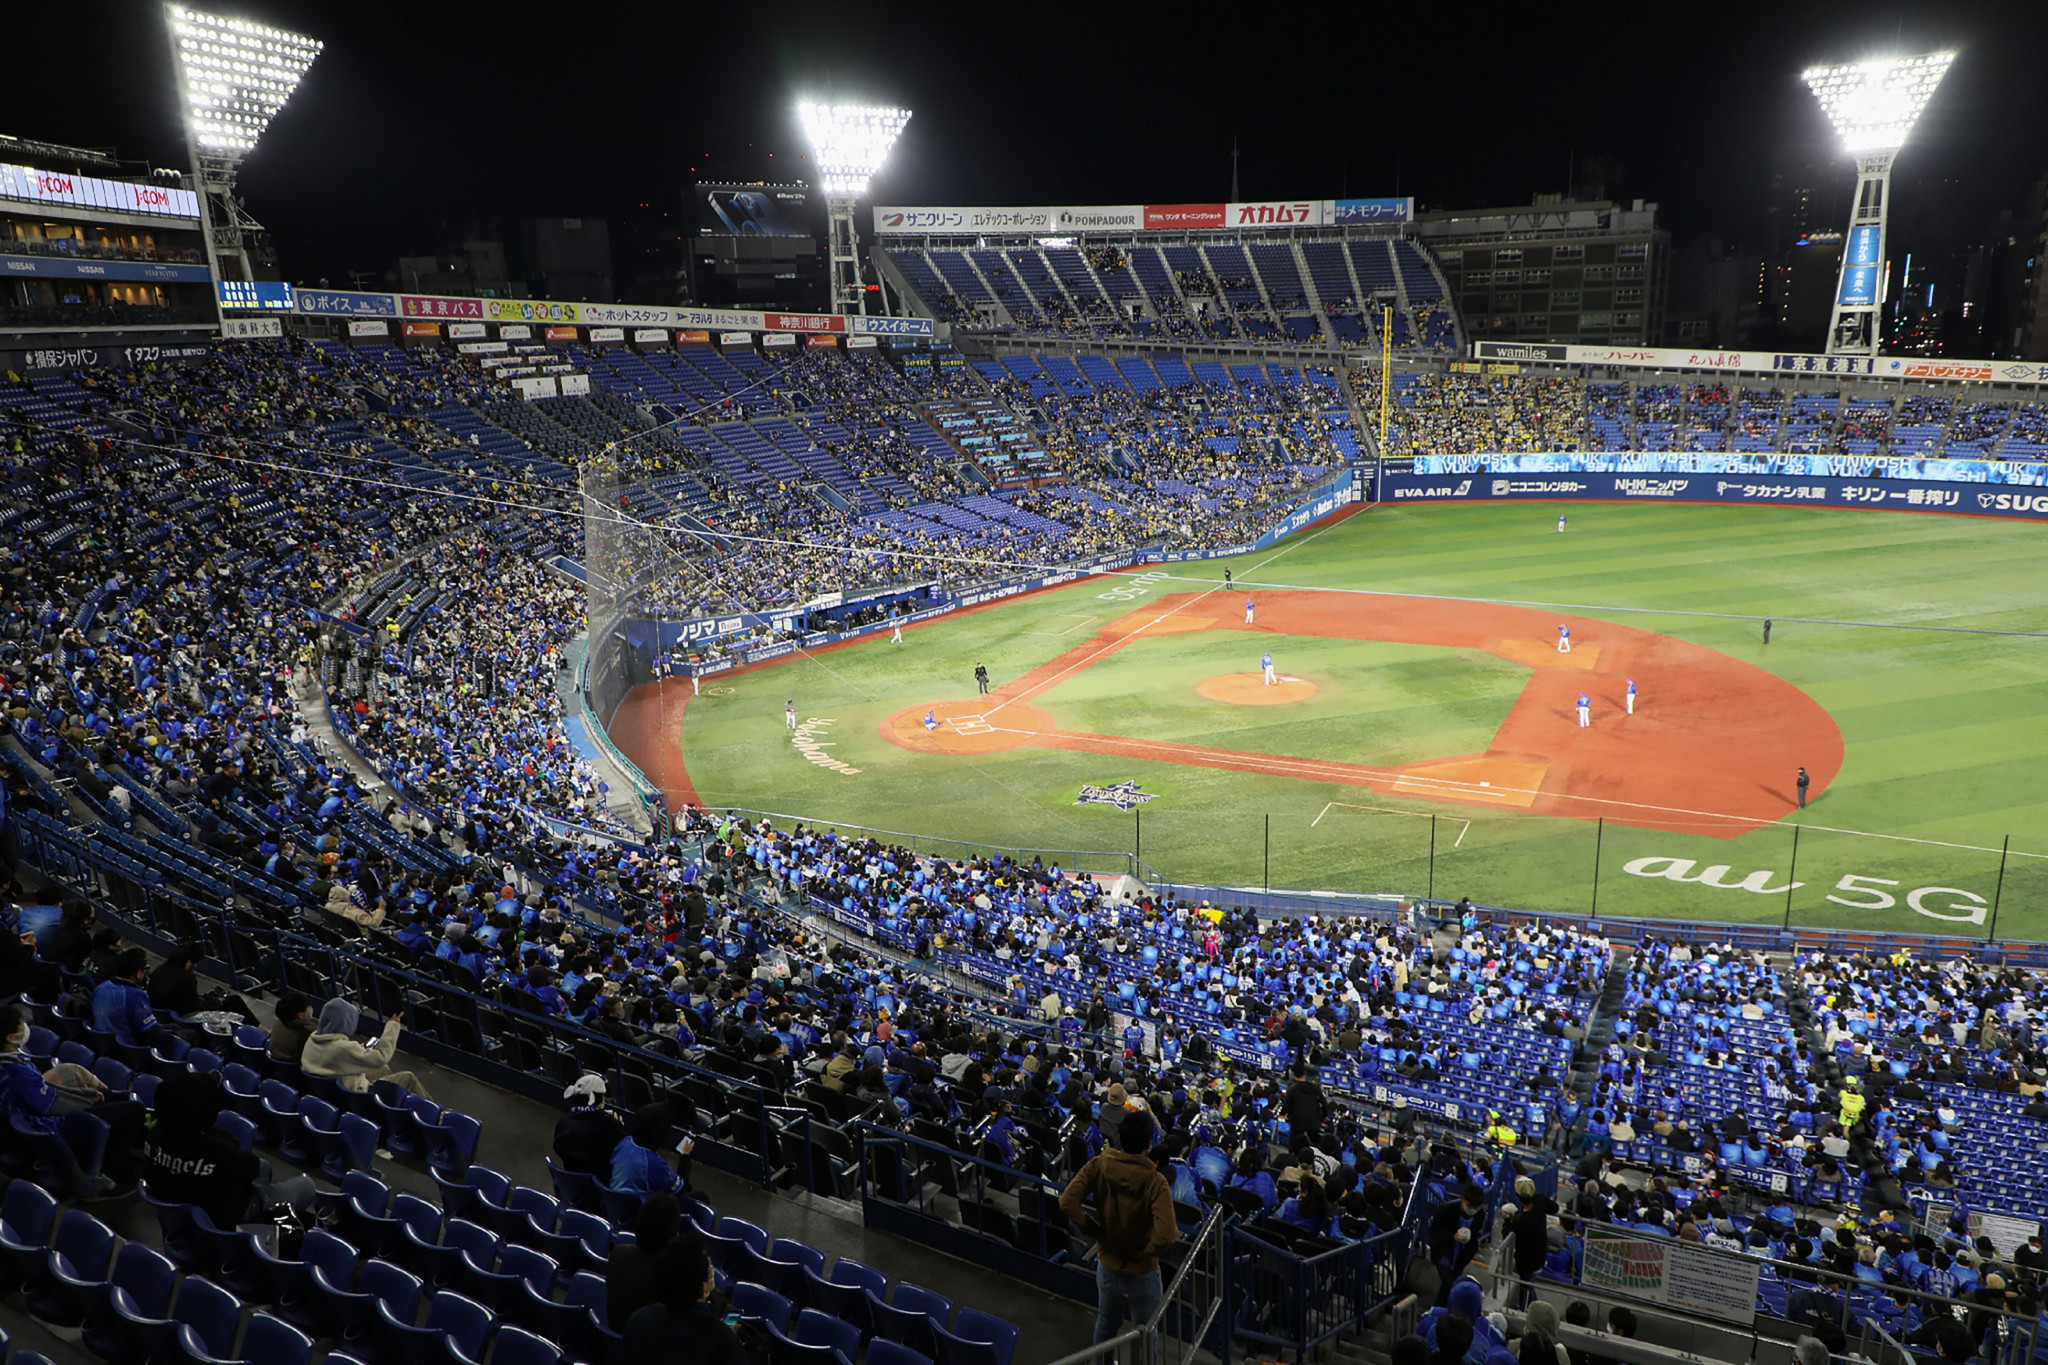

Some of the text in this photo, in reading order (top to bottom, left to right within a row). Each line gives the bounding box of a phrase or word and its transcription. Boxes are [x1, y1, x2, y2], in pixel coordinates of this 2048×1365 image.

[38, 175, 73, 195] J:COM
[135, 189, 168, 206] J:COM
[1238, 203, 1310, 224] オカムラ
[1345, 203, 1407, 219] メモワール
[906, 212, 963, 227] サニクリーン
[1075, 215, 1135, 226] POMPADOUR
[7, 261, 36, 271] NISSAN
[77, 265, 105, 274] NISSAN
[421, 300, 479, 316] 東京バス
[605, 309, 669, 323] ホットスタッフ
[779, 316, 831, 330] 神奈川銀行
[868, 319, 931, 333] ウスイホーム
[1496, 341, 1548, 359] wamiles
[1603, 351, 1655, 360] ハーバー
[35, 349, 98, 369] 損保ジャパン
[1510, 481, 1588, 492] ニコニコレンタカー
[1743, 485, 1827, 499] タカナシ乳業
[676, 620, 716, 643] ノジマ
[1622, 856, 1989, 926] au 5G
[153, 1145, 217, 1177] Angels
